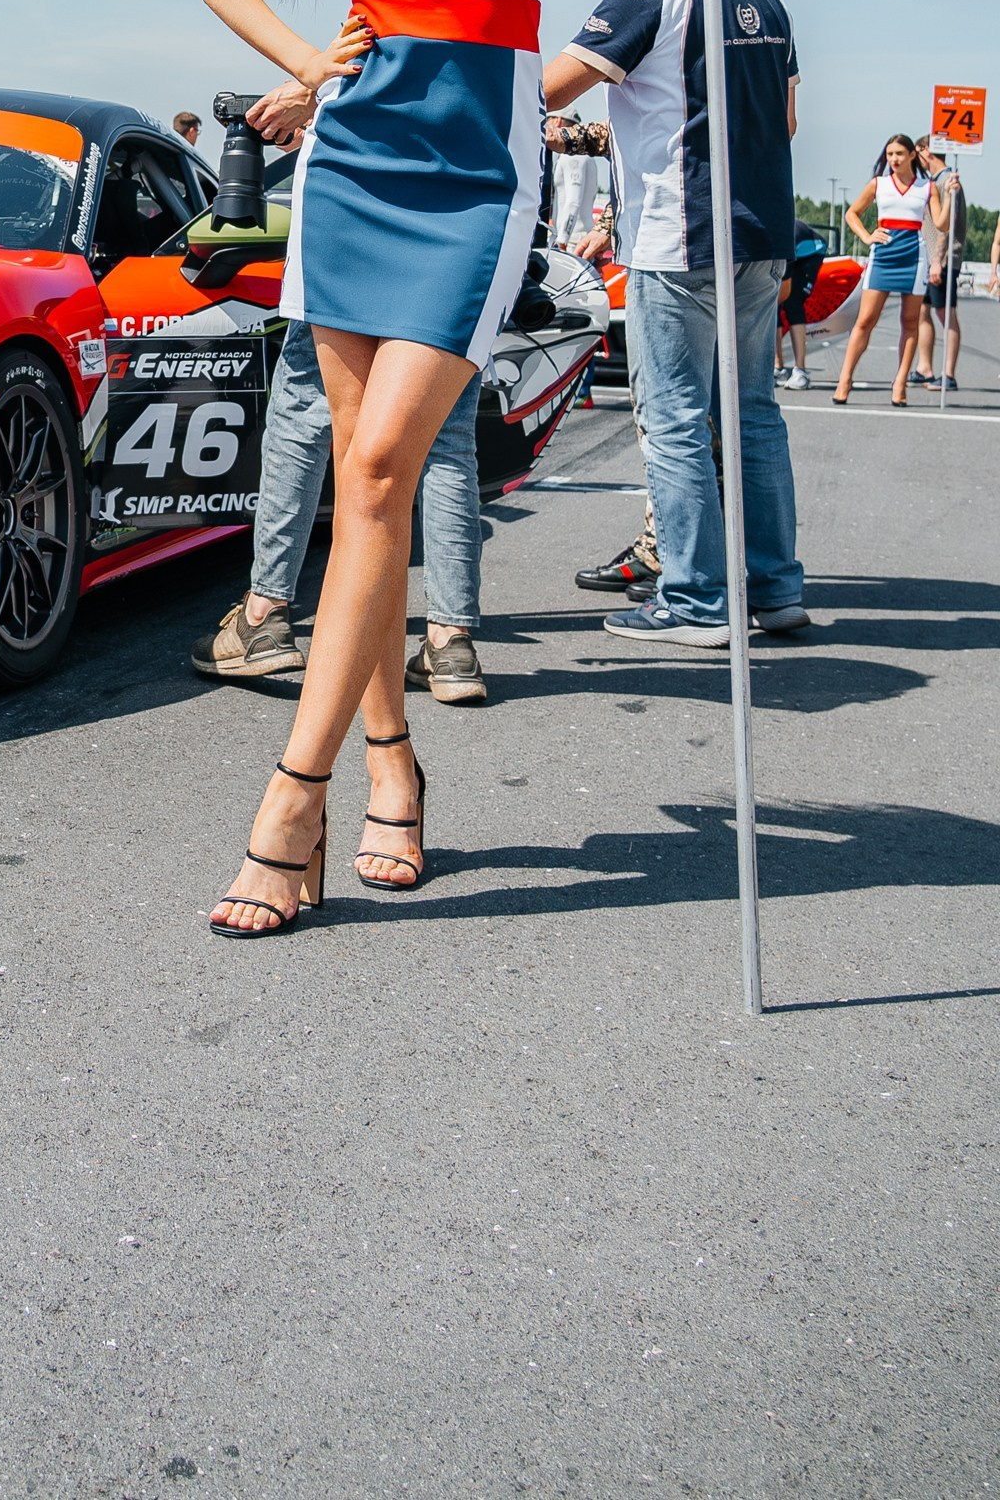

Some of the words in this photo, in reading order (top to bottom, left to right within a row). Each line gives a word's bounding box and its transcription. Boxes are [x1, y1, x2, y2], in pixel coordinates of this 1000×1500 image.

[942, 108, 976, 132] 74
[71, 142, 103, 250] @porschesprintchallenge
[112, 401, 246, 478] 46
[122, 495, 174, 515] SMP
[176, 493, 260, 514] RACING
